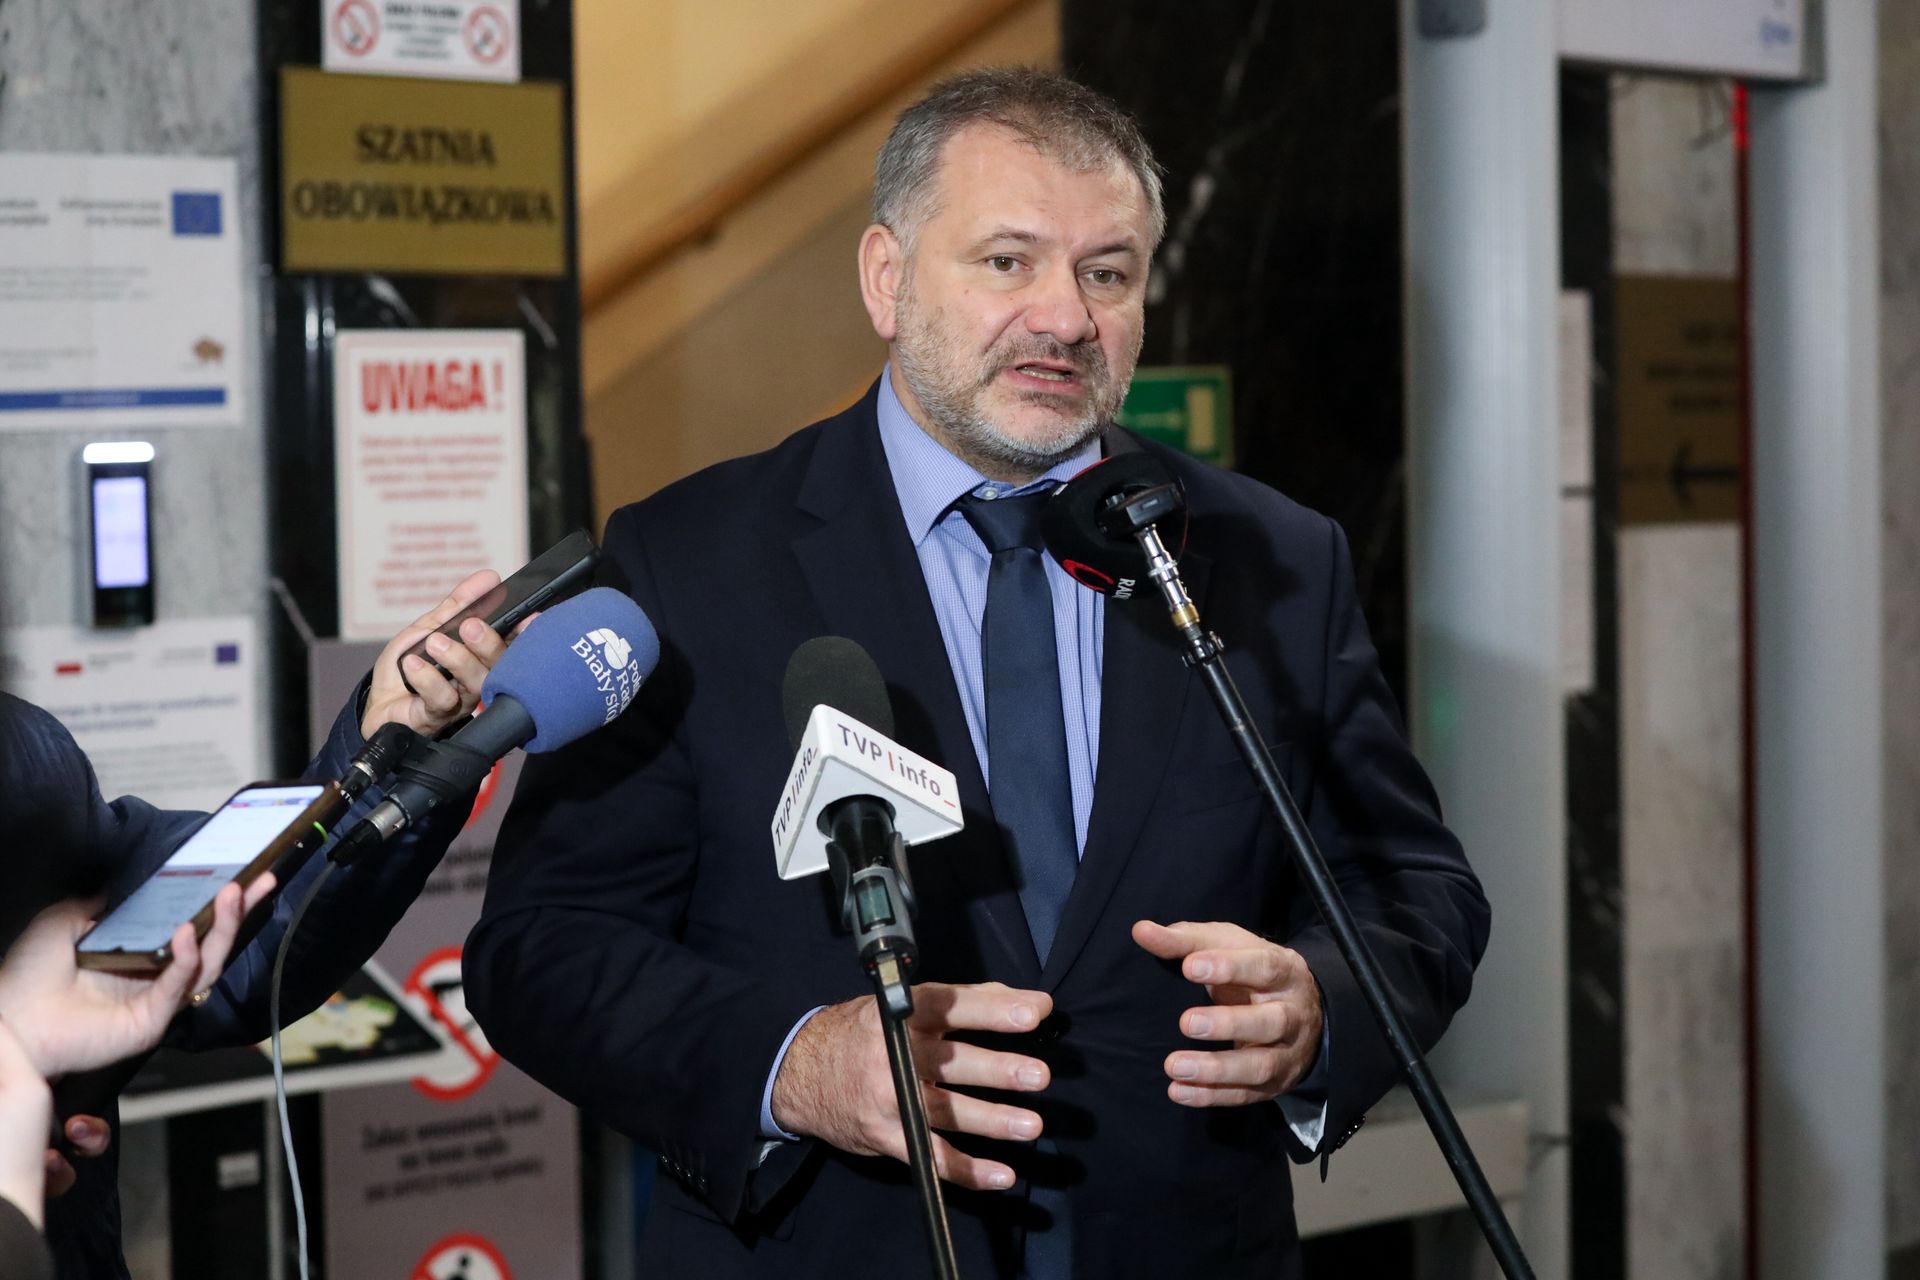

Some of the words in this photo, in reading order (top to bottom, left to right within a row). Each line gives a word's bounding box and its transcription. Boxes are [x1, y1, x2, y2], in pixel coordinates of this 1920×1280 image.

[356, 125, 497, 167] SZATNIA
[294, 180, 555, 225] OBOWIĄZKOWA
[571, 637, 618, 726] Białysto
